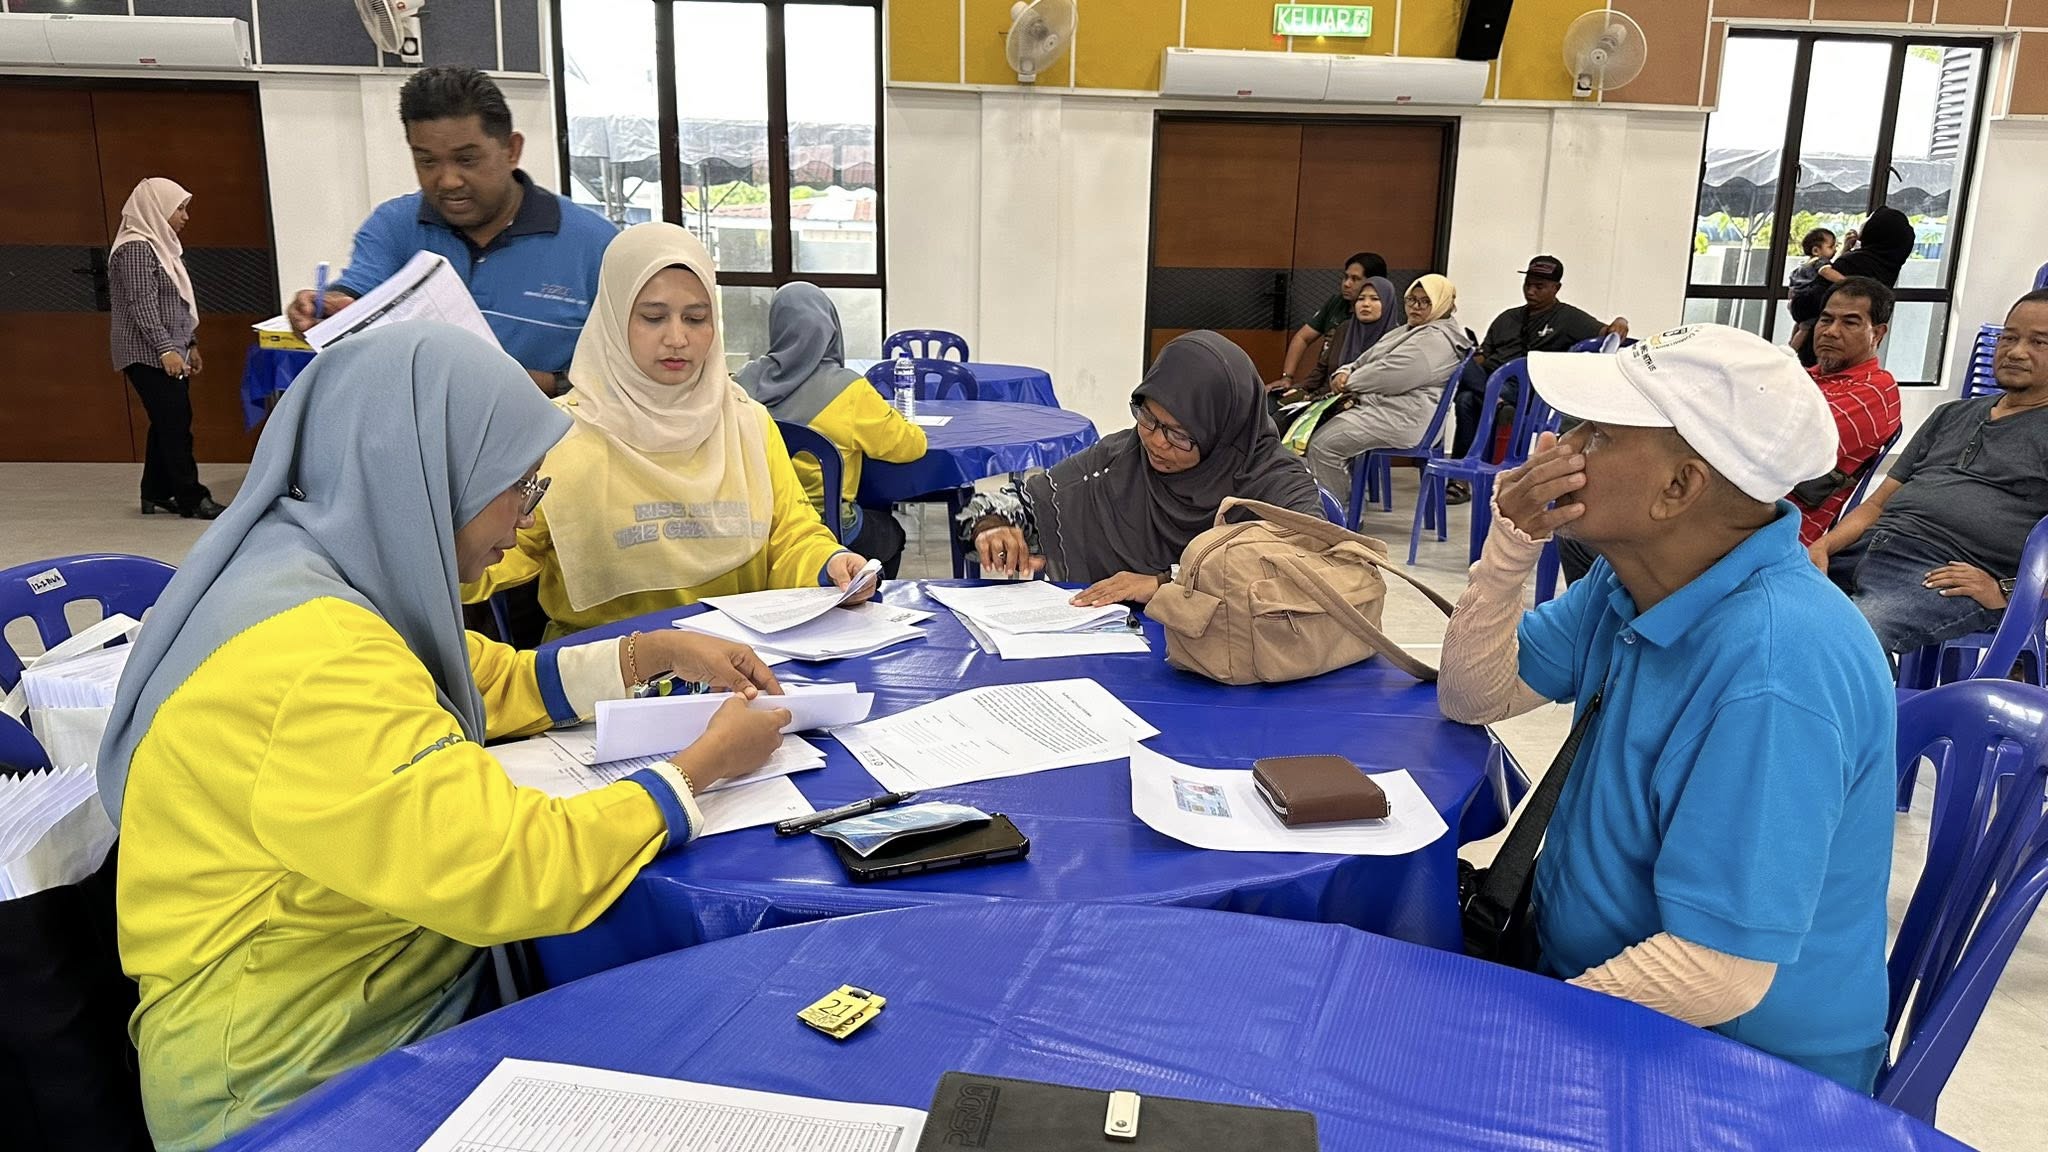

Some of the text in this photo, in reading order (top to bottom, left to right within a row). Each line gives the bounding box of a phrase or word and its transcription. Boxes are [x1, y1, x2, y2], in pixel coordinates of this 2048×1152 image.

[1278, 7, 1351, 32] KELUAR
[634, 501, 686, 522] RISE
[819, 999, 853, 1018] 21
